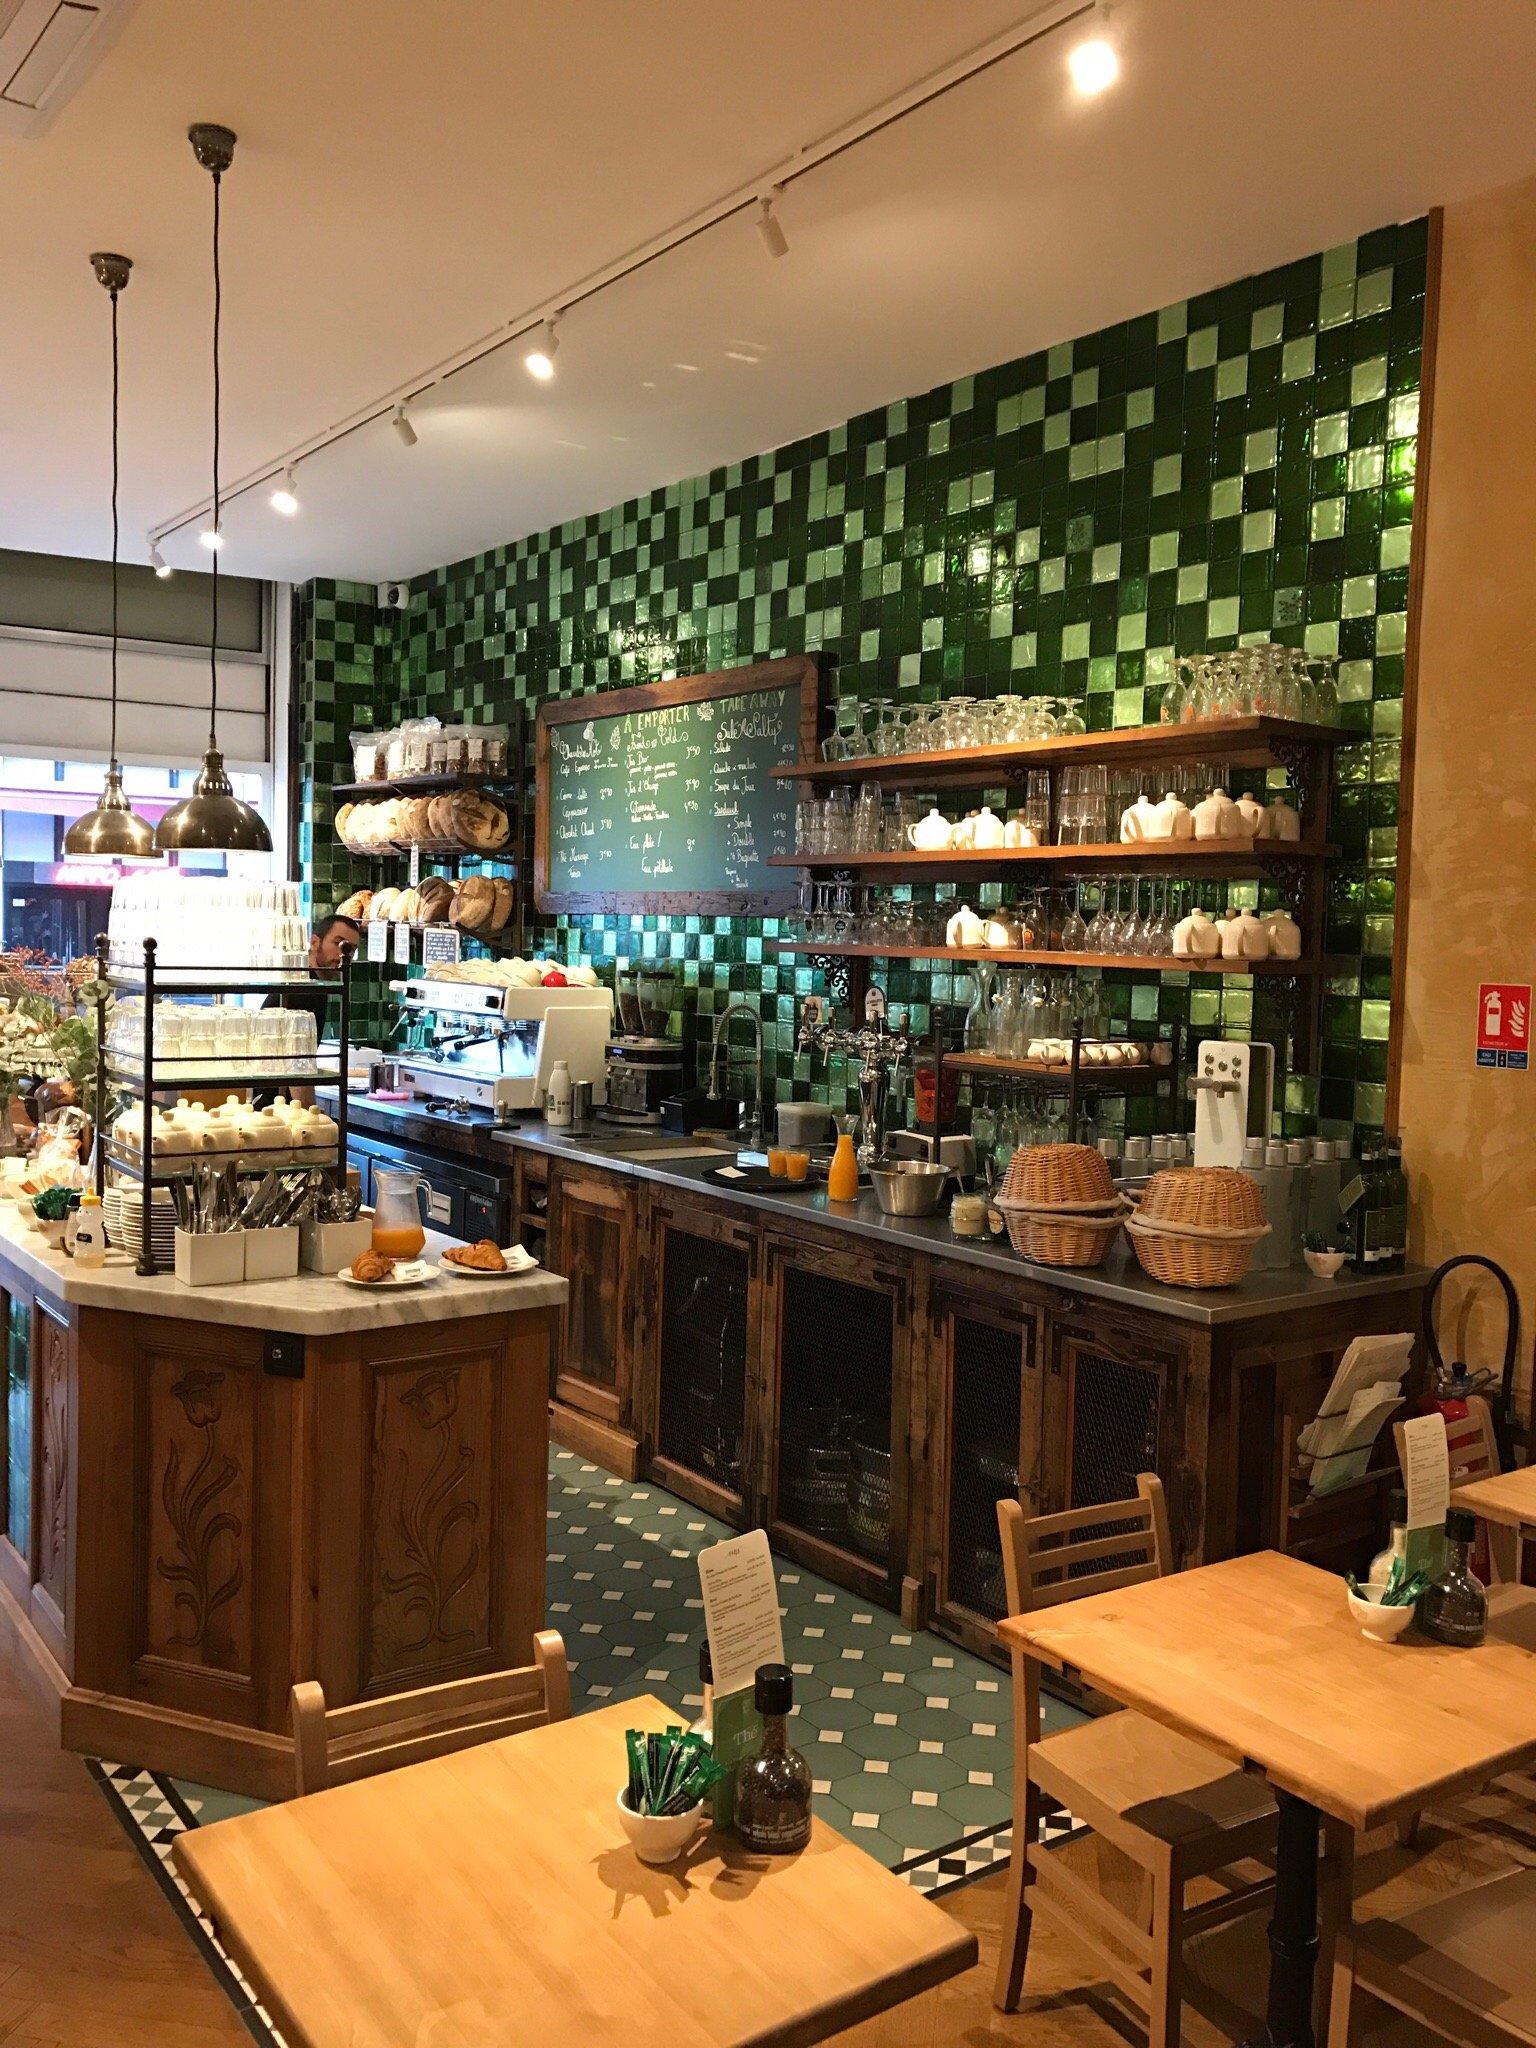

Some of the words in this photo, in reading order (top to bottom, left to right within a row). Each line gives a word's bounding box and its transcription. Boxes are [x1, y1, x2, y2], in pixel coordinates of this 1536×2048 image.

[720, 695, 747, 714] TAKE
[749, 690, 785, 709] AWAY
[637, 705, 690, 731] EMPORTER
